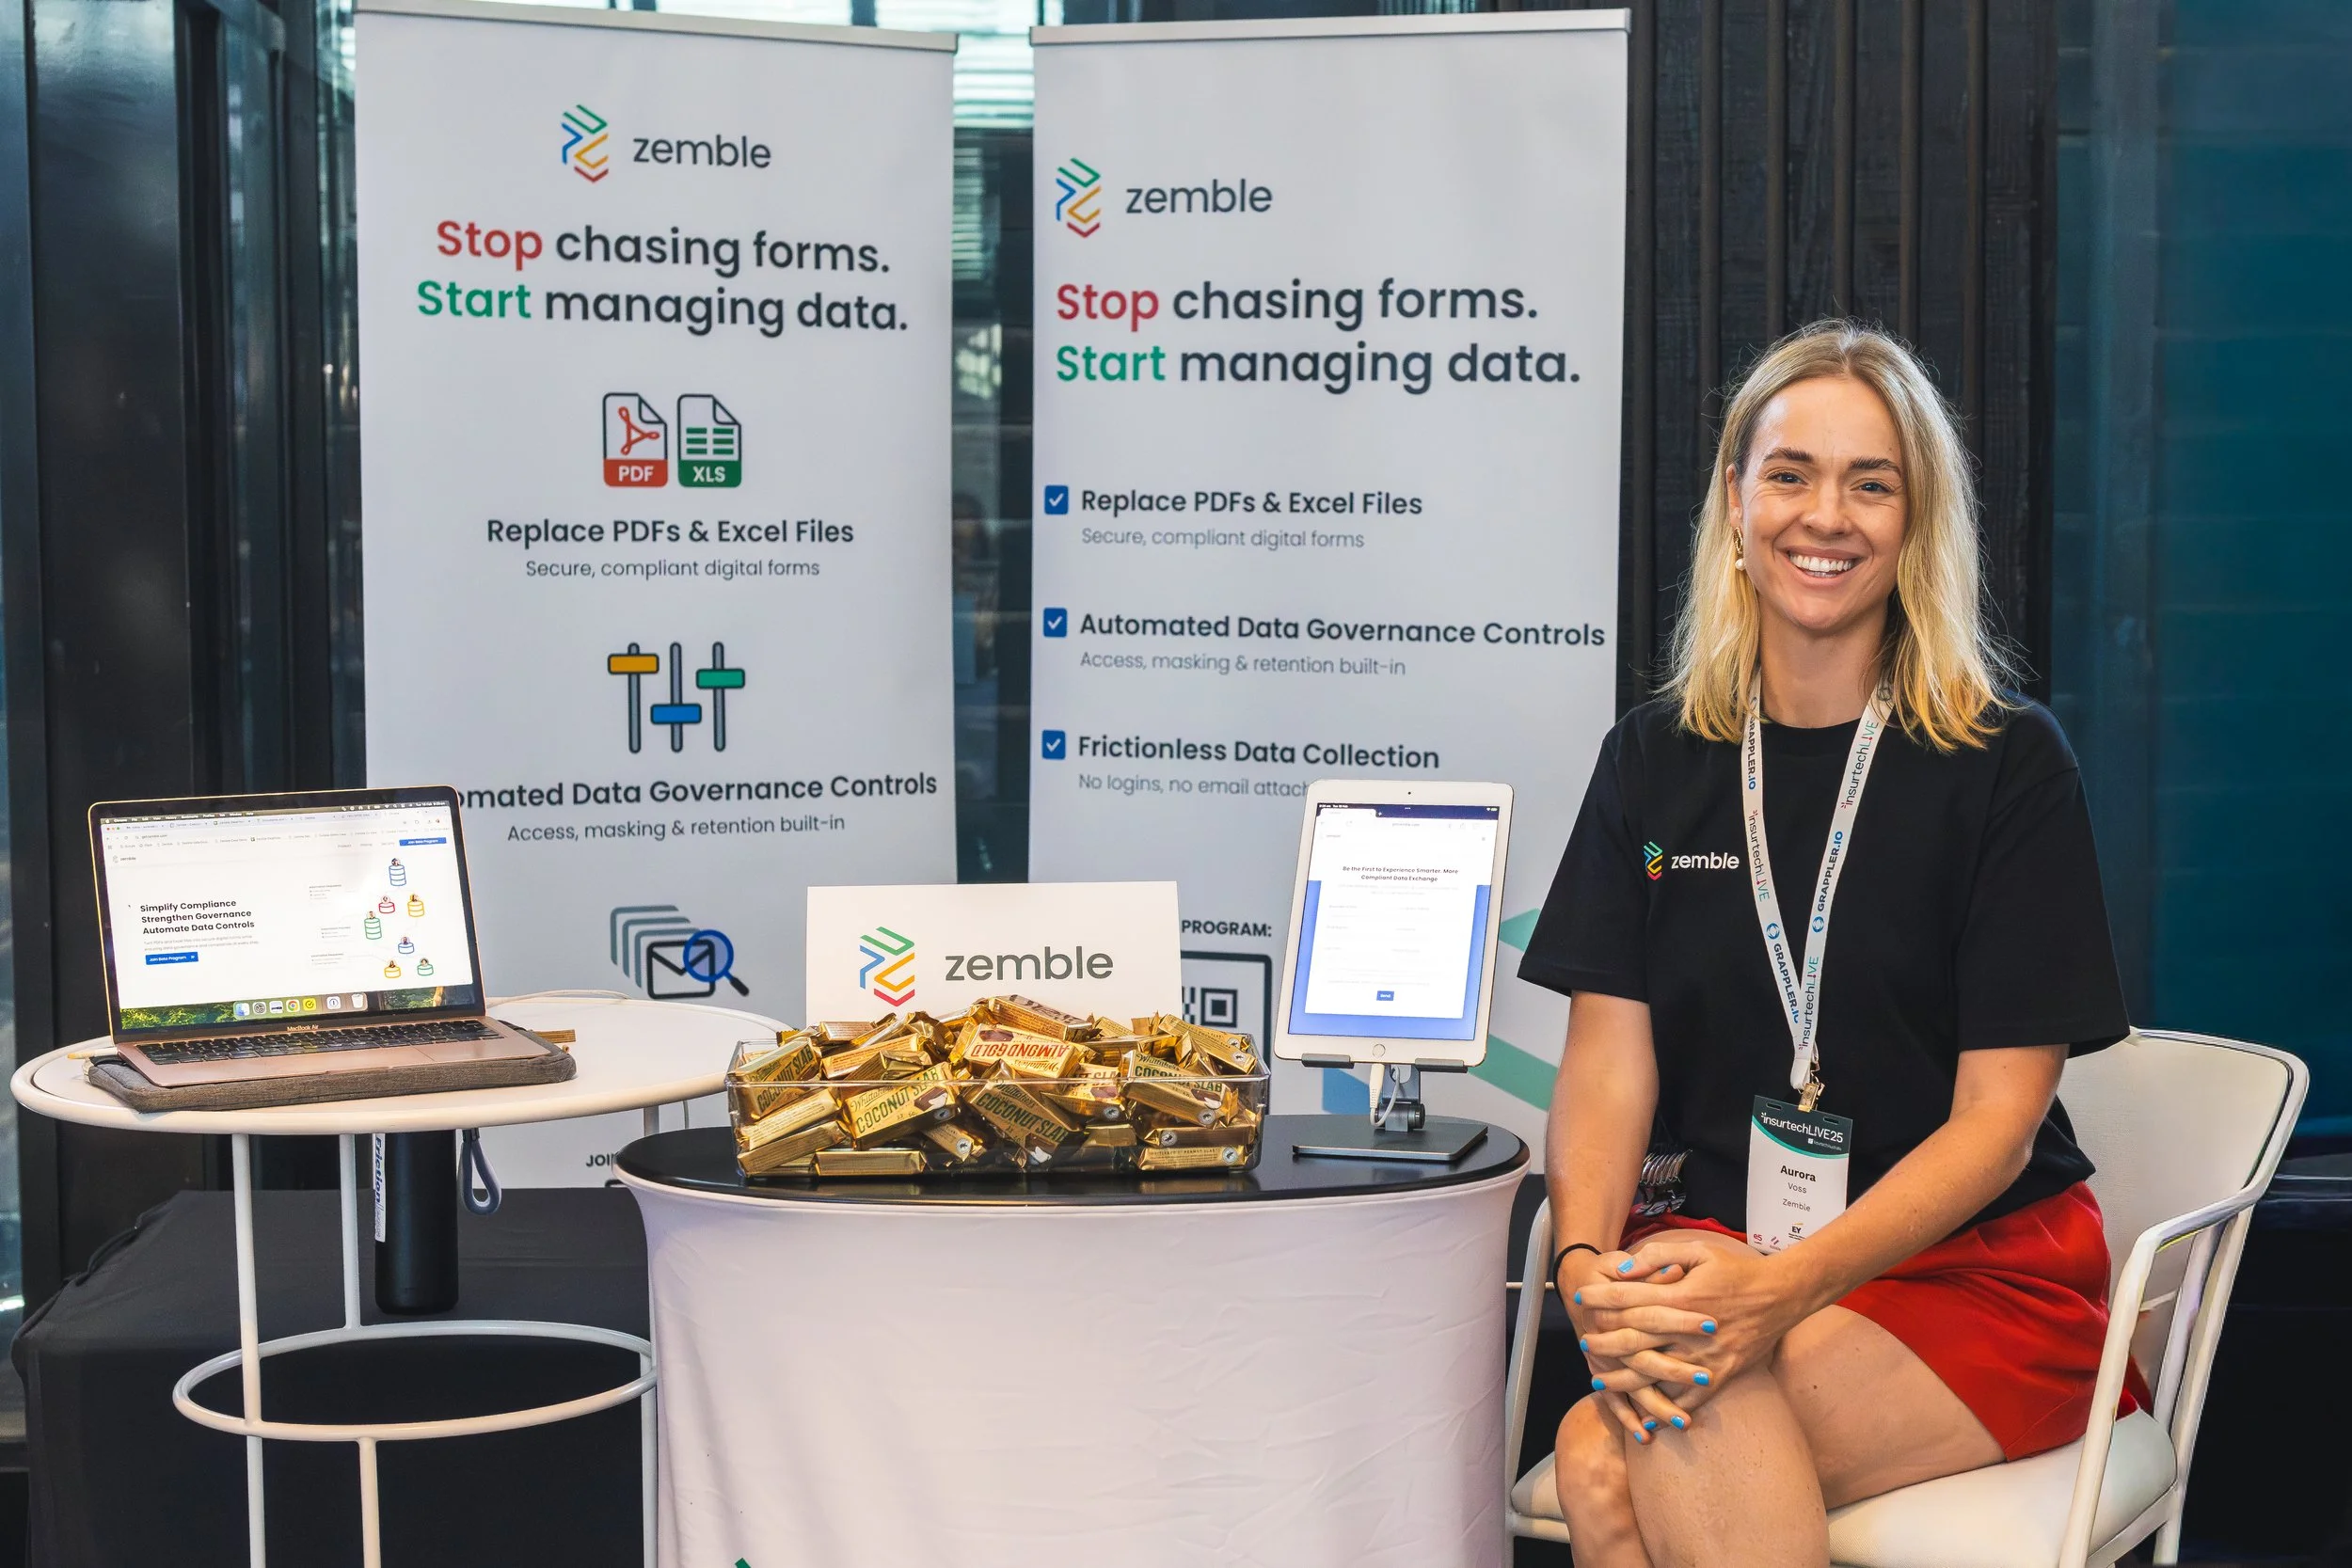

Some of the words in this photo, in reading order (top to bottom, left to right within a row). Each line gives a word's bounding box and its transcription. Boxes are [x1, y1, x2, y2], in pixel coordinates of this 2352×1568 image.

[633, 135, 771, 168] zemble
[1126, 179, 1272, 214] zemble
[437, 221, 542, 271] Stop
[556, 225, 739, 278] chasing
[754, 230, 889, 273] forms.
[418, 280, 531, 318] Start
[547, 287, 784, 338] managing
[797, 293, 907, 330] data.
[1057, 284, 1158, 332] Stop
[1173, 278, 1362, 331] chasing
[1378, 277, 1537, 318] forms.
[1057, 346, 1166, 381] Start
[1182, 341, 1431, 395] managing
[1449, 343, 1580, 382] data.
[619, 466, 654, 483] PDF
[693, 467, 725, 482] XLS
[1083, 490, 1186, 517] Replace
[1195, 492, 1255, 512] PDFs
[1263, 492, 1281, 513] &
[1290, 492, 1354, 514] Excel
[1363, 491, 1422, 515] Files
[488, 519, 604, 549] Replace
[613, 520, 680, 542] PDFs
[689, 520, 708, 542] &
[719, 520, 787, 542] Excel
[797, 519, 853, 542] Files
[1082, 528, 1146, 546] Secure,
[1152, 530, 1245, 549] compliant
[1251, 530, 1306, 551] digital
[1311, 531, 1364, 547] forms
[527, 561, 595, 578] Secure,
[601, 560, 698, 580] compliant
[705, 560, 762, 580] digital
[769, 560, 819, 575] forms
[1081, 614, 1230, 637] Automated
[1238, 617, 1298, 639] Data
[1307, 619, 1475, 642] Governance
[1484, 623, 1604, 645] Controls
[1080, 652, 1147, 670] Access,
[1152, 655, 1230, 675] masking
[1235, 655, 1248, 671] &
[1254, 657, 1334, 673] retention
[1340, 657, 1406, 675] built-in
[1079, 735, 1226, 760] Frictionless
[1235, 741, 1295, 764] Data
[1303, 744, 1438, 768] Collection
[573, 783, 641, 805] Data
[650, 781, 823, 802] Governance
[831, 772, 936, 797] Controls
[1079, 774, 1103, 789] No
[1107, 775, 1164, 796] logins,
[1169, 780, 1193, 793] no
[1199, 779, 1248, 794] email
[508, 826, 578, 841] Access,
[585, 820, 665, 841] masking
[672, 820, 684, 835] &
[691, 817, 774, 834] retention
[781, 815, 844, 832] built-in
[1671, 852, 1740, 869] zemble
[1818, 831, 1843, 912] GRAPPLER.IO
[140, 903, 179, 913] Simplify
[180, 900, 237, 911] Compliance
[141, 913, 194, 924] Strengthen
[196, 910, 252, 920] Governance
[143, 926, 190, 935] Automate
[215, 921, 255, 930] Controls
[1182, 920, 1271, 937] PROGRAM:
[946, 946, 1113, 981] zemble
[792, 1044, 814, 1075] SLAB
[971, 1043, 1009, 1057] GOLD
[1007, 1044, 1071, 1057] ALMOND
[856, 1085, 911, 1133] COCONUT
[978, 1093, 1042, 1130] COCONUT
[586, 1153, 614, 1167] JOI
[1780, 1164, 1816, 1181] Aurora
[1788, 1182, 1807, 1194] Voss
[1782, 1198, 1811, 1212] Zemble
[1791, 1226, 1802, 1234] EY
